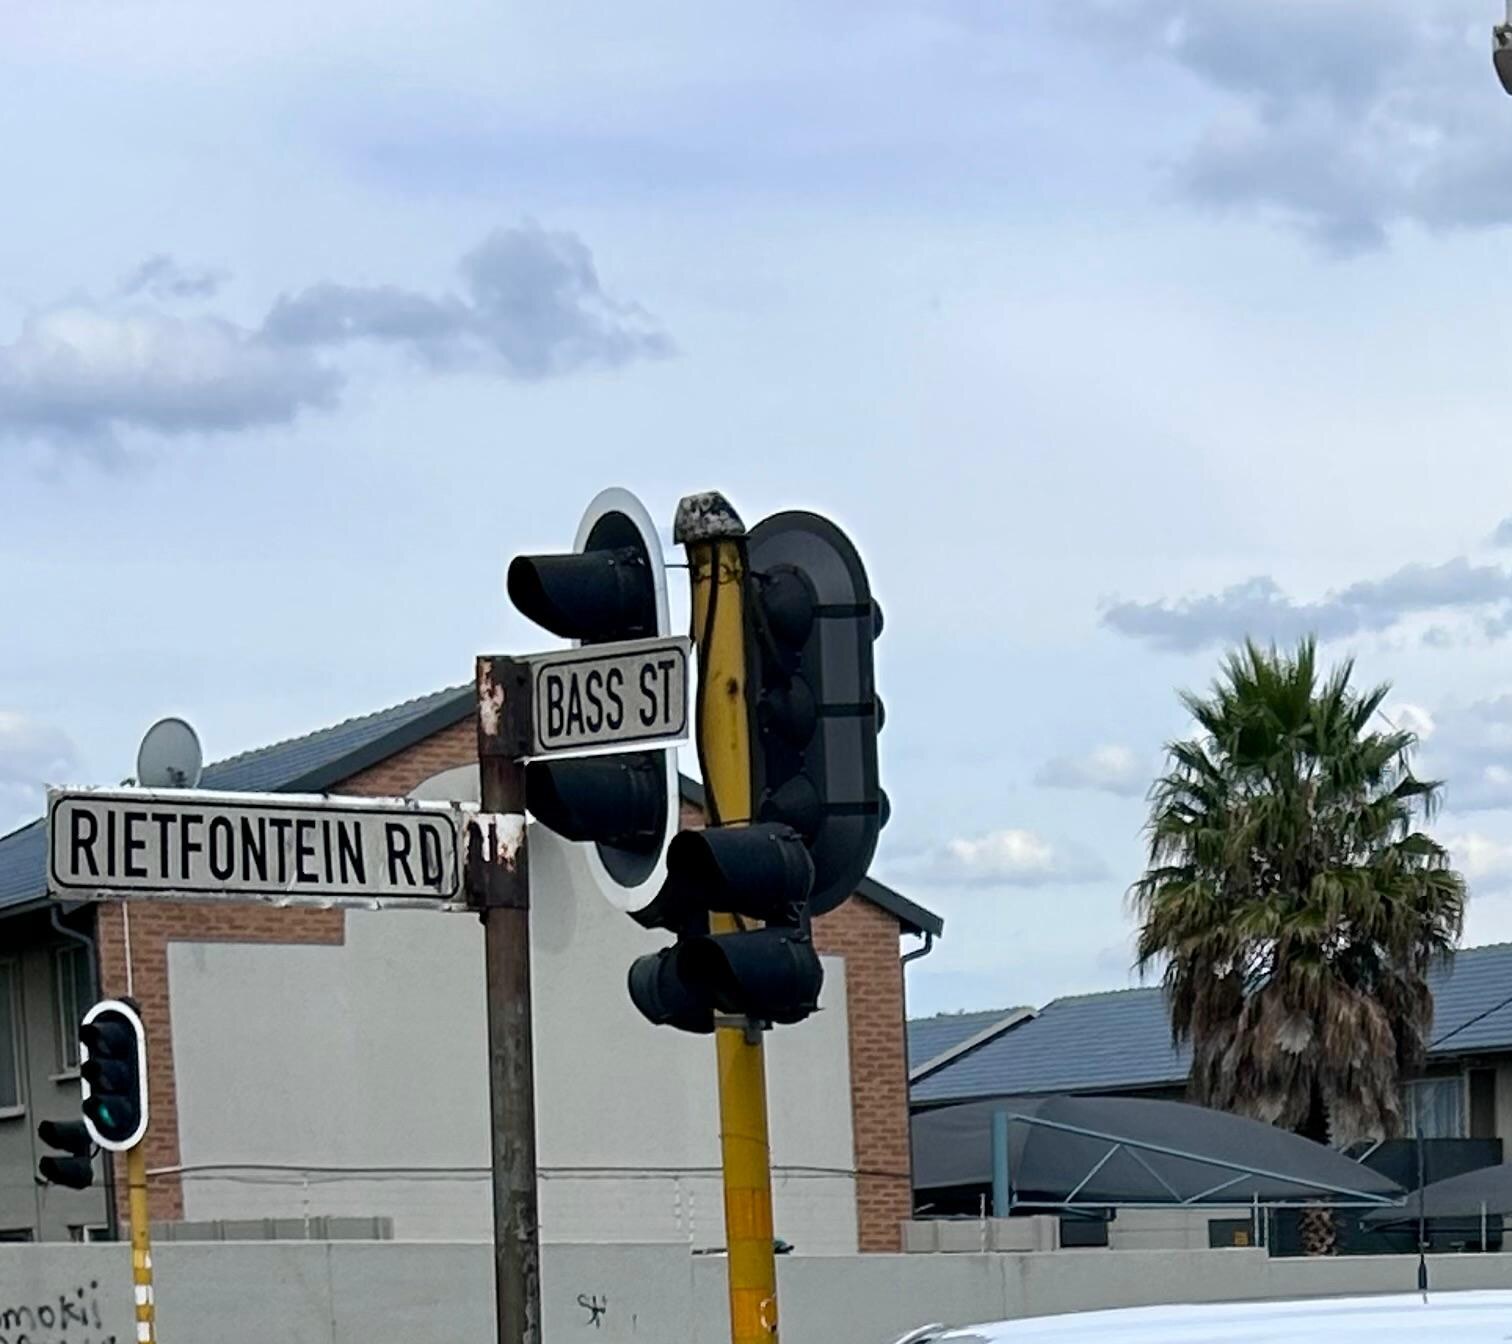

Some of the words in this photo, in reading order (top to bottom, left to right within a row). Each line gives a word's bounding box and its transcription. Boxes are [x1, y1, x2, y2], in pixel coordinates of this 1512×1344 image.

[547, 667, 624, 738] BASS
[639, 660, 675, 727] ST
[69, 807, 366, 885] RIETFONTEIN
[385, 821, 443, 888] RD
